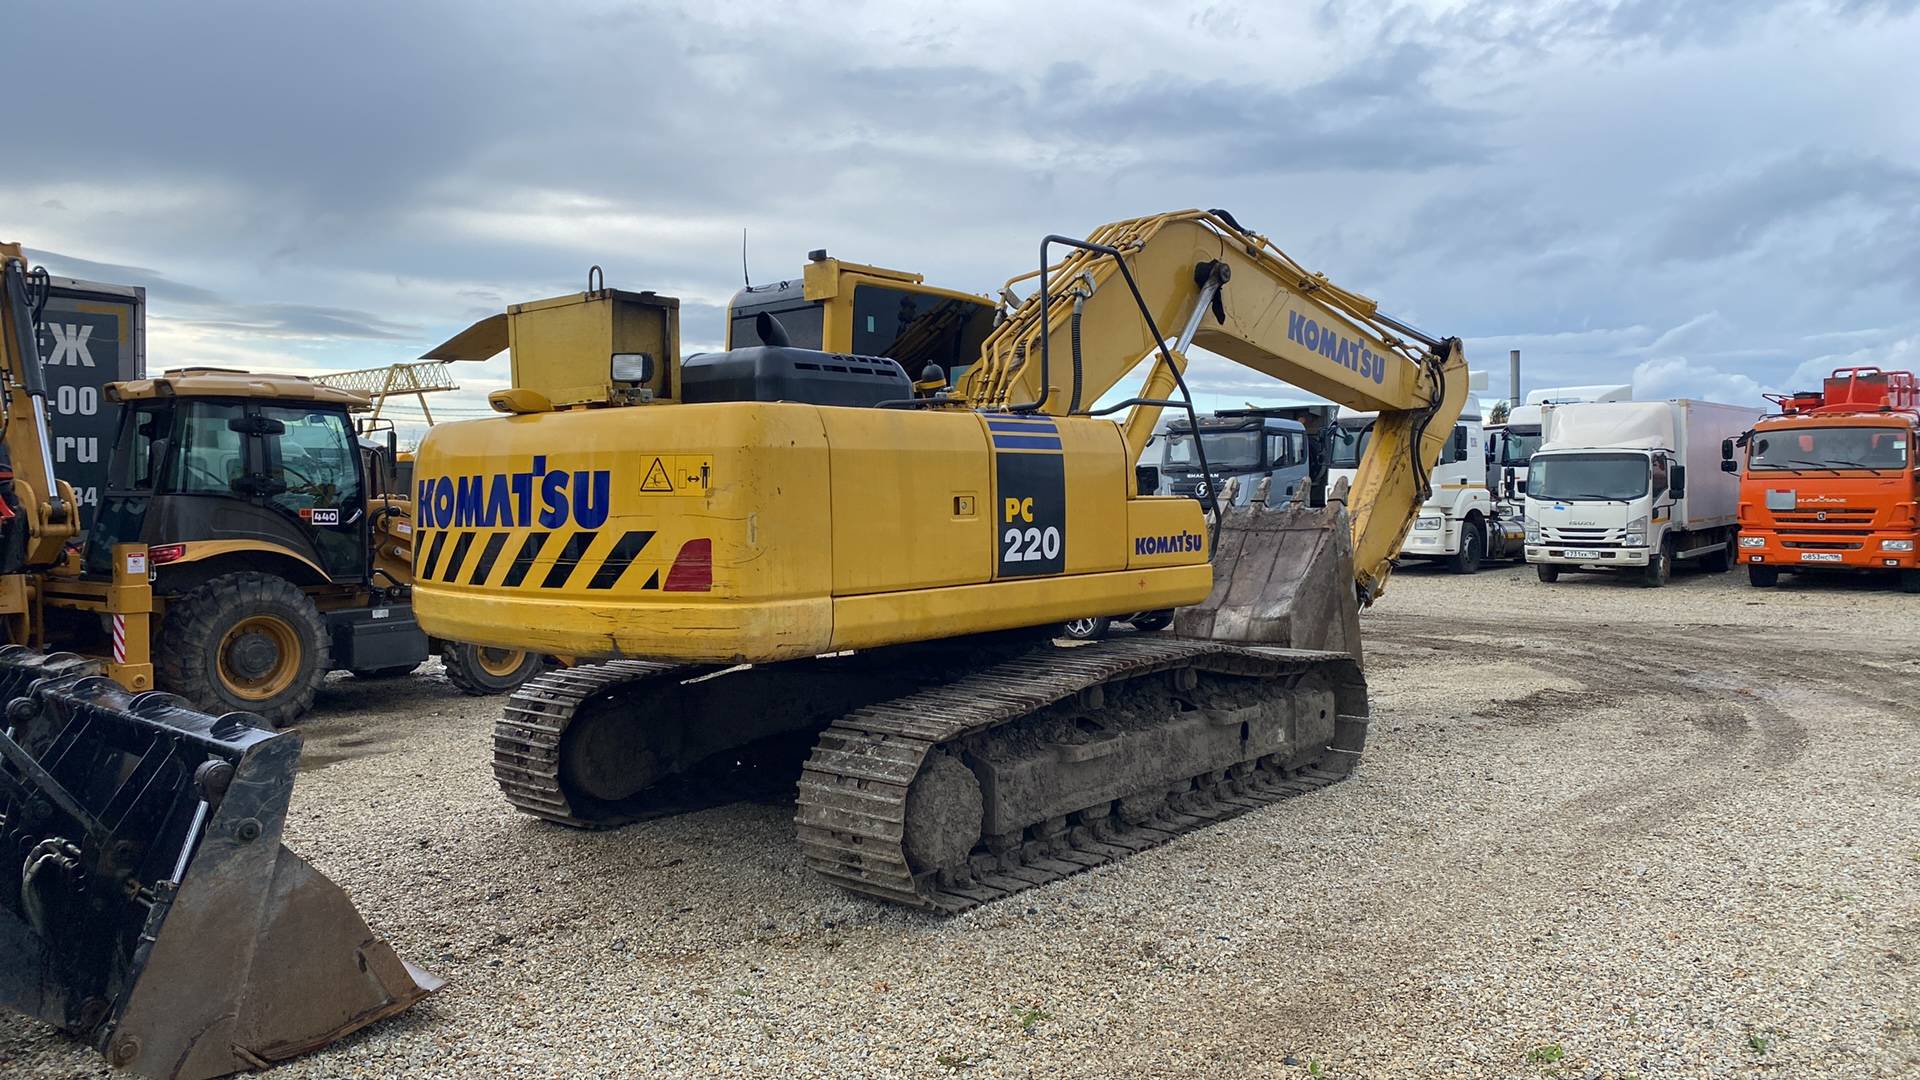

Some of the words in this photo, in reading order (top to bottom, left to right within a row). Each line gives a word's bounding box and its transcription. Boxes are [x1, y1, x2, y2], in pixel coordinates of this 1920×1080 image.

[1288, 309, 1385, 385] KOMATSU
[56, 436, 98, 463] ru
[417, 455, 611, 530] KOMATSU
[314, 512, 337, 521] 440
[1005, 497, 1034, 523] PC
[1004, 526, 1062, 563] 220
[1135, 530, 1202, 555] KOMATSU
